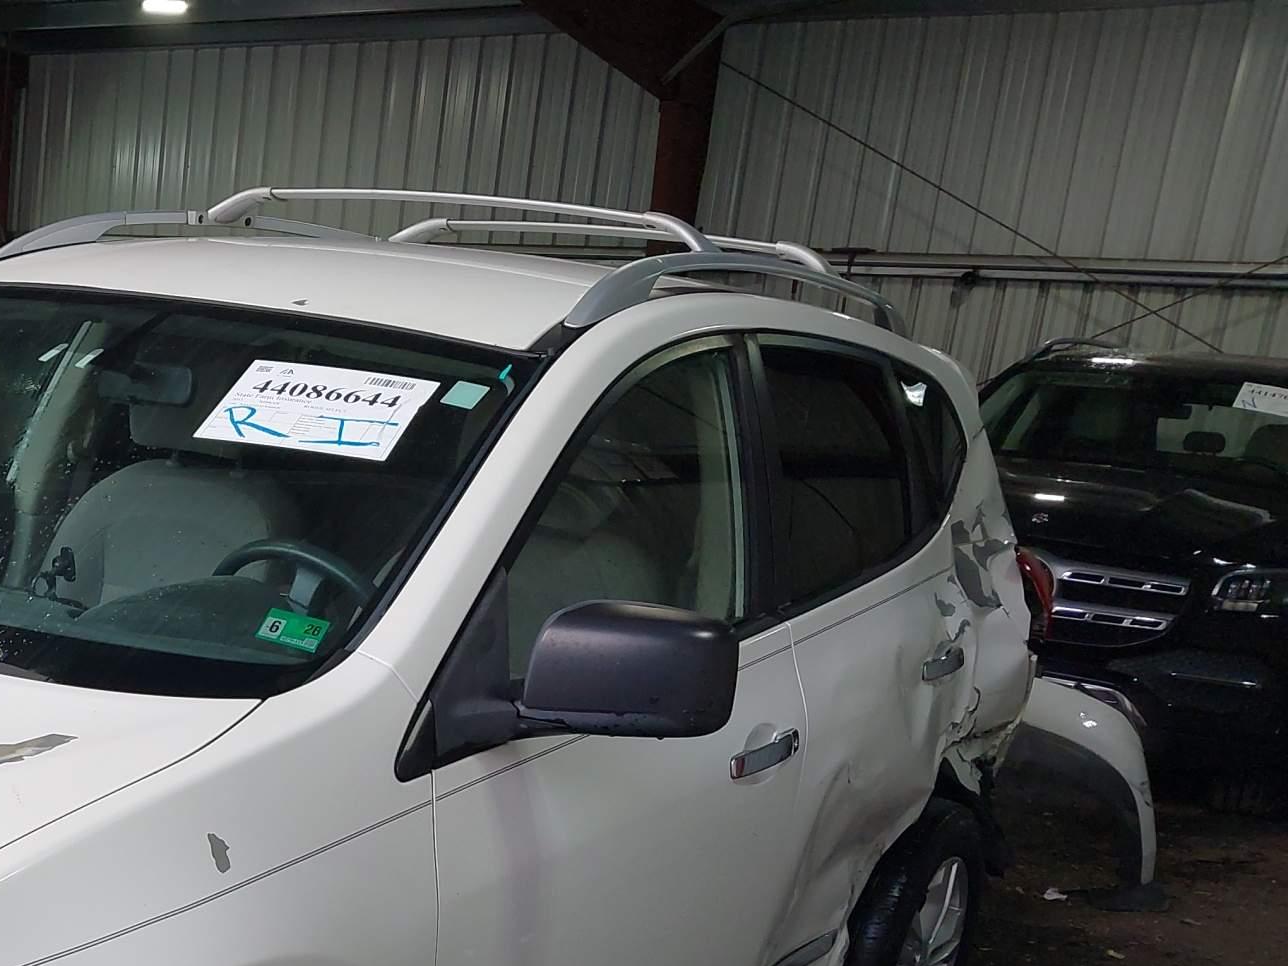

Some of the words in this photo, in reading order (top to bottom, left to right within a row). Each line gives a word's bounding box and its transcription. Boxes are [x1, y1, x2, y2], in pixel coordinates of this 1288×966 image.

[252, 380, 401, 408] 44086644
[223, 405, 291, 438] R
[268, 620, 282, 633] 6
